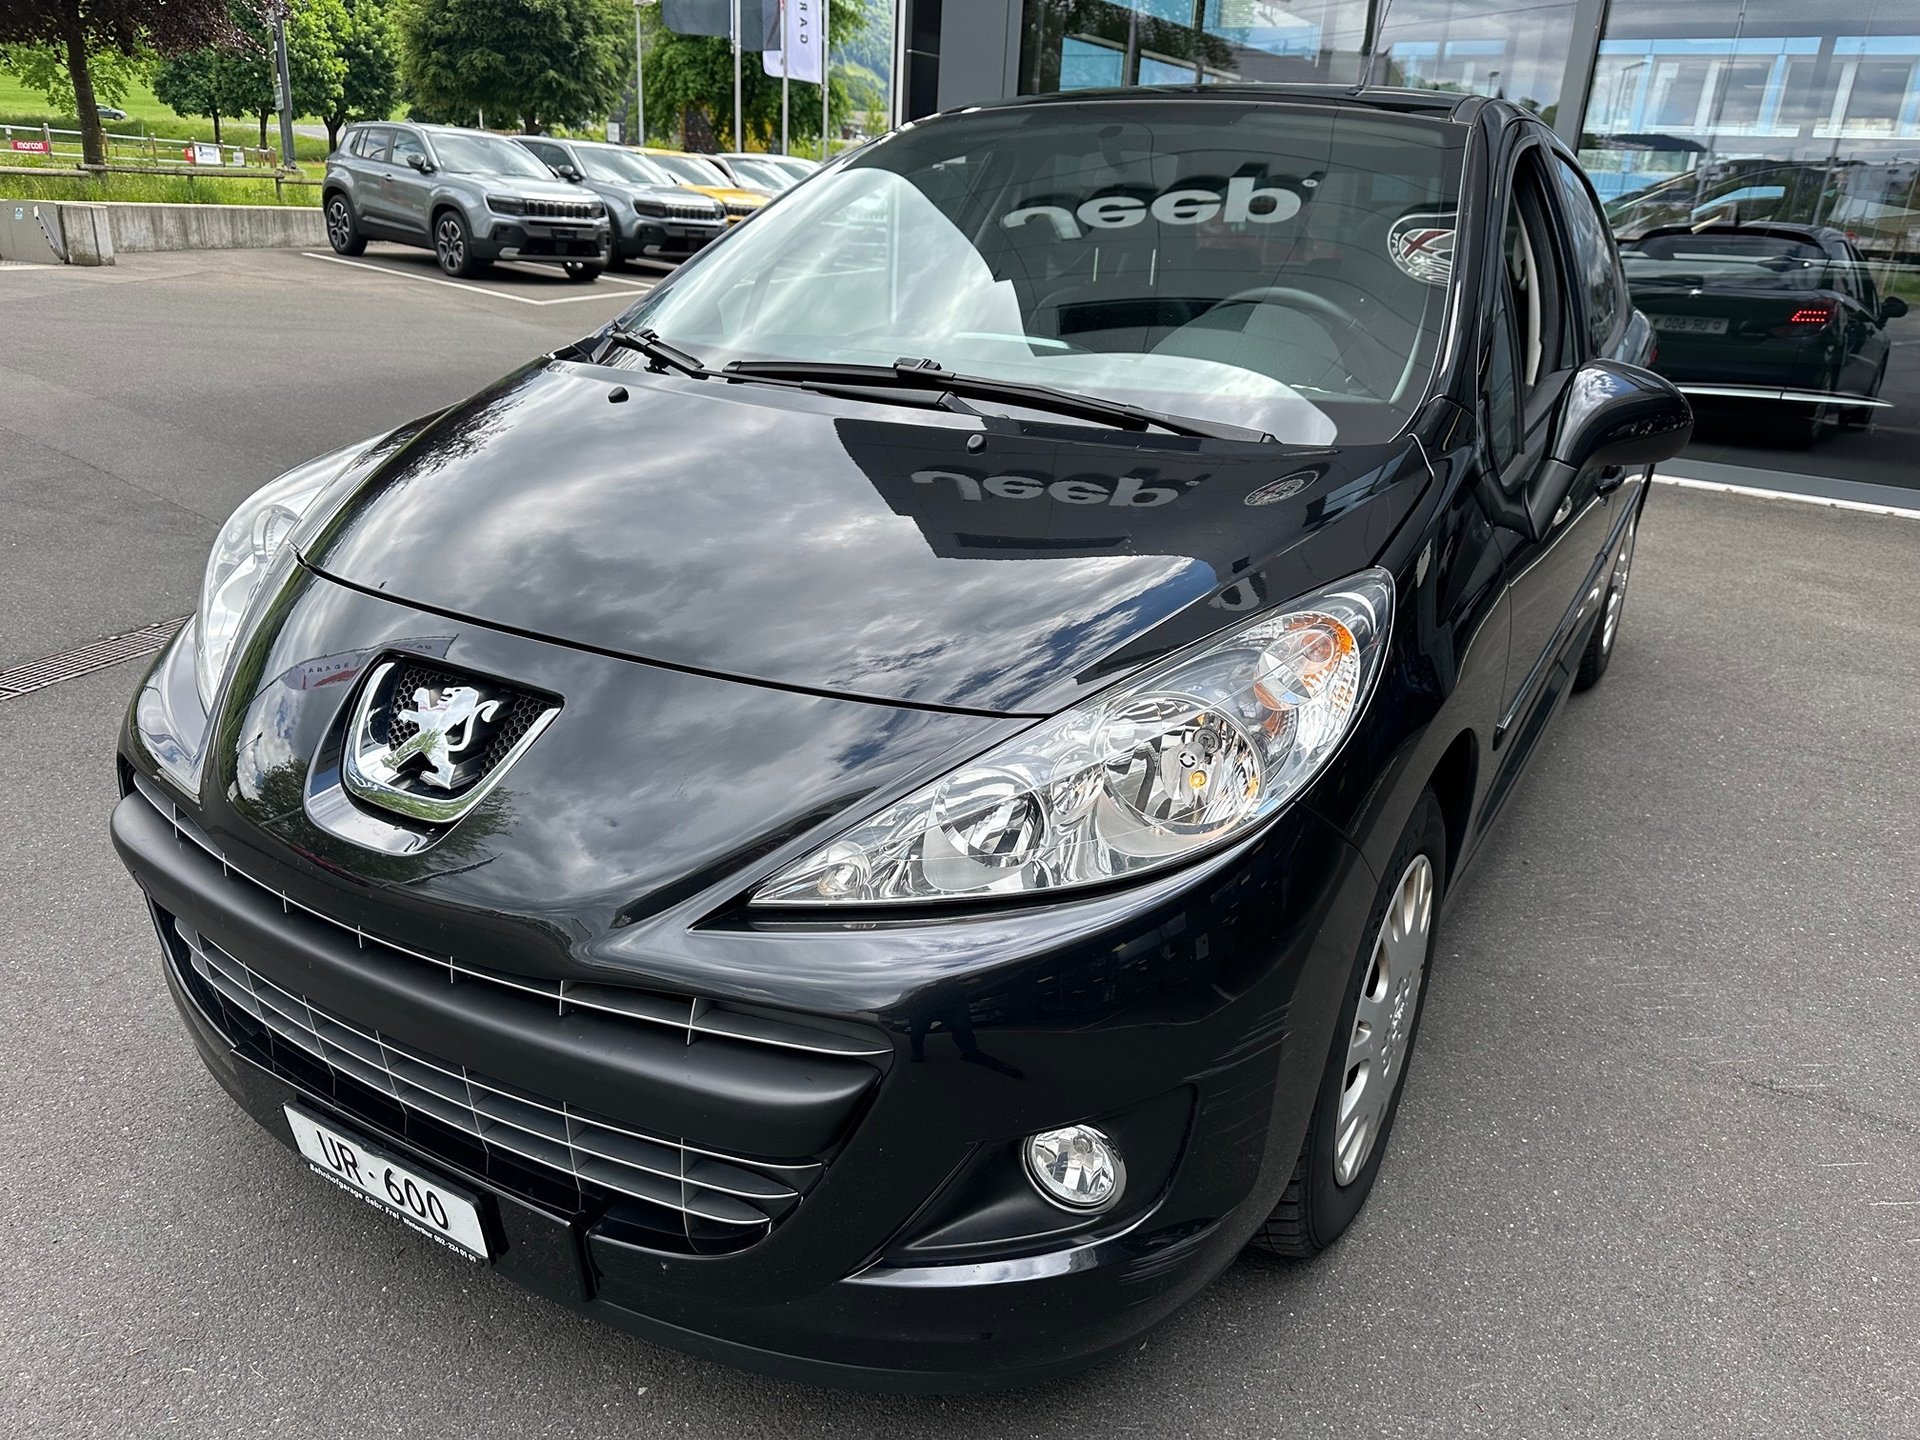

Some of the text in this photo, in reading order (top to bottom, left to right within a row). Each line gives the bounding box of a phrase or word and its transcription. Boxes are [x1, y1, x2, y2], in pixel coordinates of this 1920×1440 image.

[309, 1163, 363, 1199] Bahnhofgarage
[316, 1130, 365, 1185] UR
[384, 1167, 449, 1229] 600
